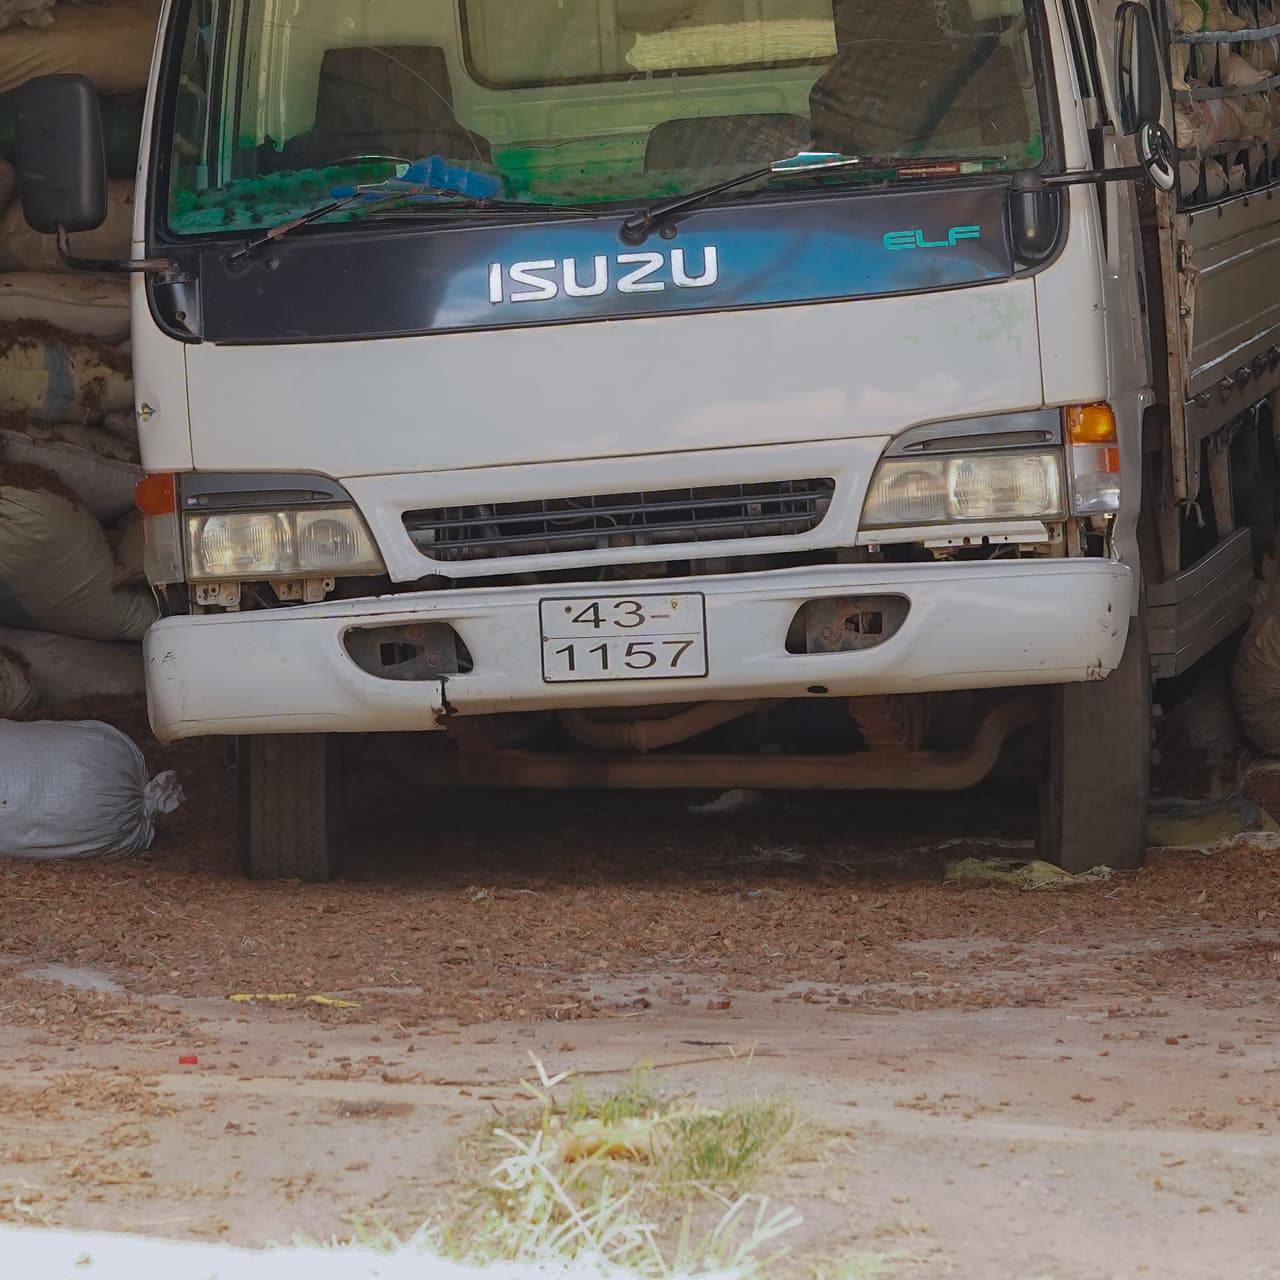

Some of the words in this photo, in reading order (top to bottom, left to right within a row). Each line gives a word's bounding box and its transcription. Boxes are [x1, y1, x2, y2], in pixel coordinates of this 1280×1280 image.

[883, 225, 980, 250] ELF
[487, 245, 718, 304] ISUZU
[556, 640, 694, 671] 1157
